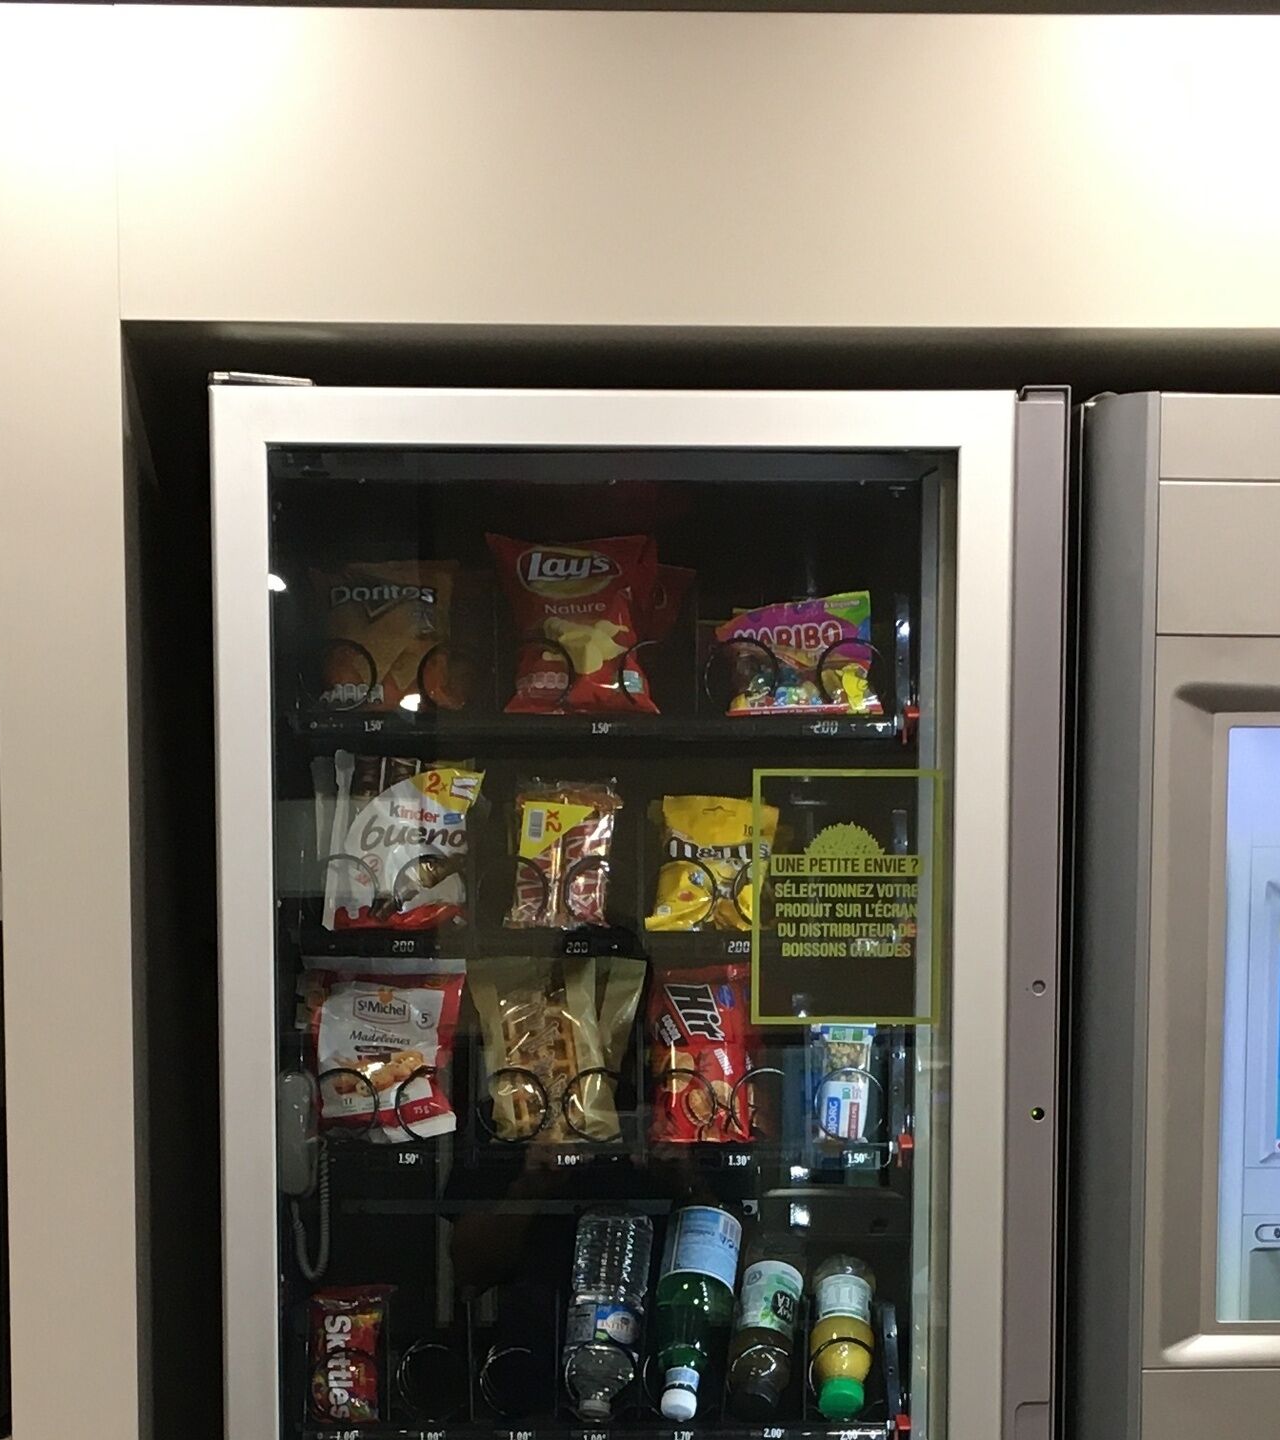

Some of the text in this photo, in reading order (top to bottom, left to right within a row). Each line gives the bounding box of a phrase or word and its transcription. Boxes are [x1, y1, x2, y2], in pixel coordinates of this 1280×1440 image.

[527, 551, 610, 582] Lay's
[543, 602, 607, 615] Nature
[389, 800, 439, 824] kinder
[360, 814, 468, 852] bueno
[775, 857, 919, 874] UNE PETITE ENVIE ?
[774, 879, 919, 899] SÉLECTIONNEZ VOTRE
[775, 899, 919, 918] PRODUIT SUR L'ÉCRAN
[777, 922, 918, 938] DU DISTRIBUTEUR DE
[781, 941, 912, 958] BOISSONS CHAUDES
[349, 1030, 411, 1046] Madeleines
